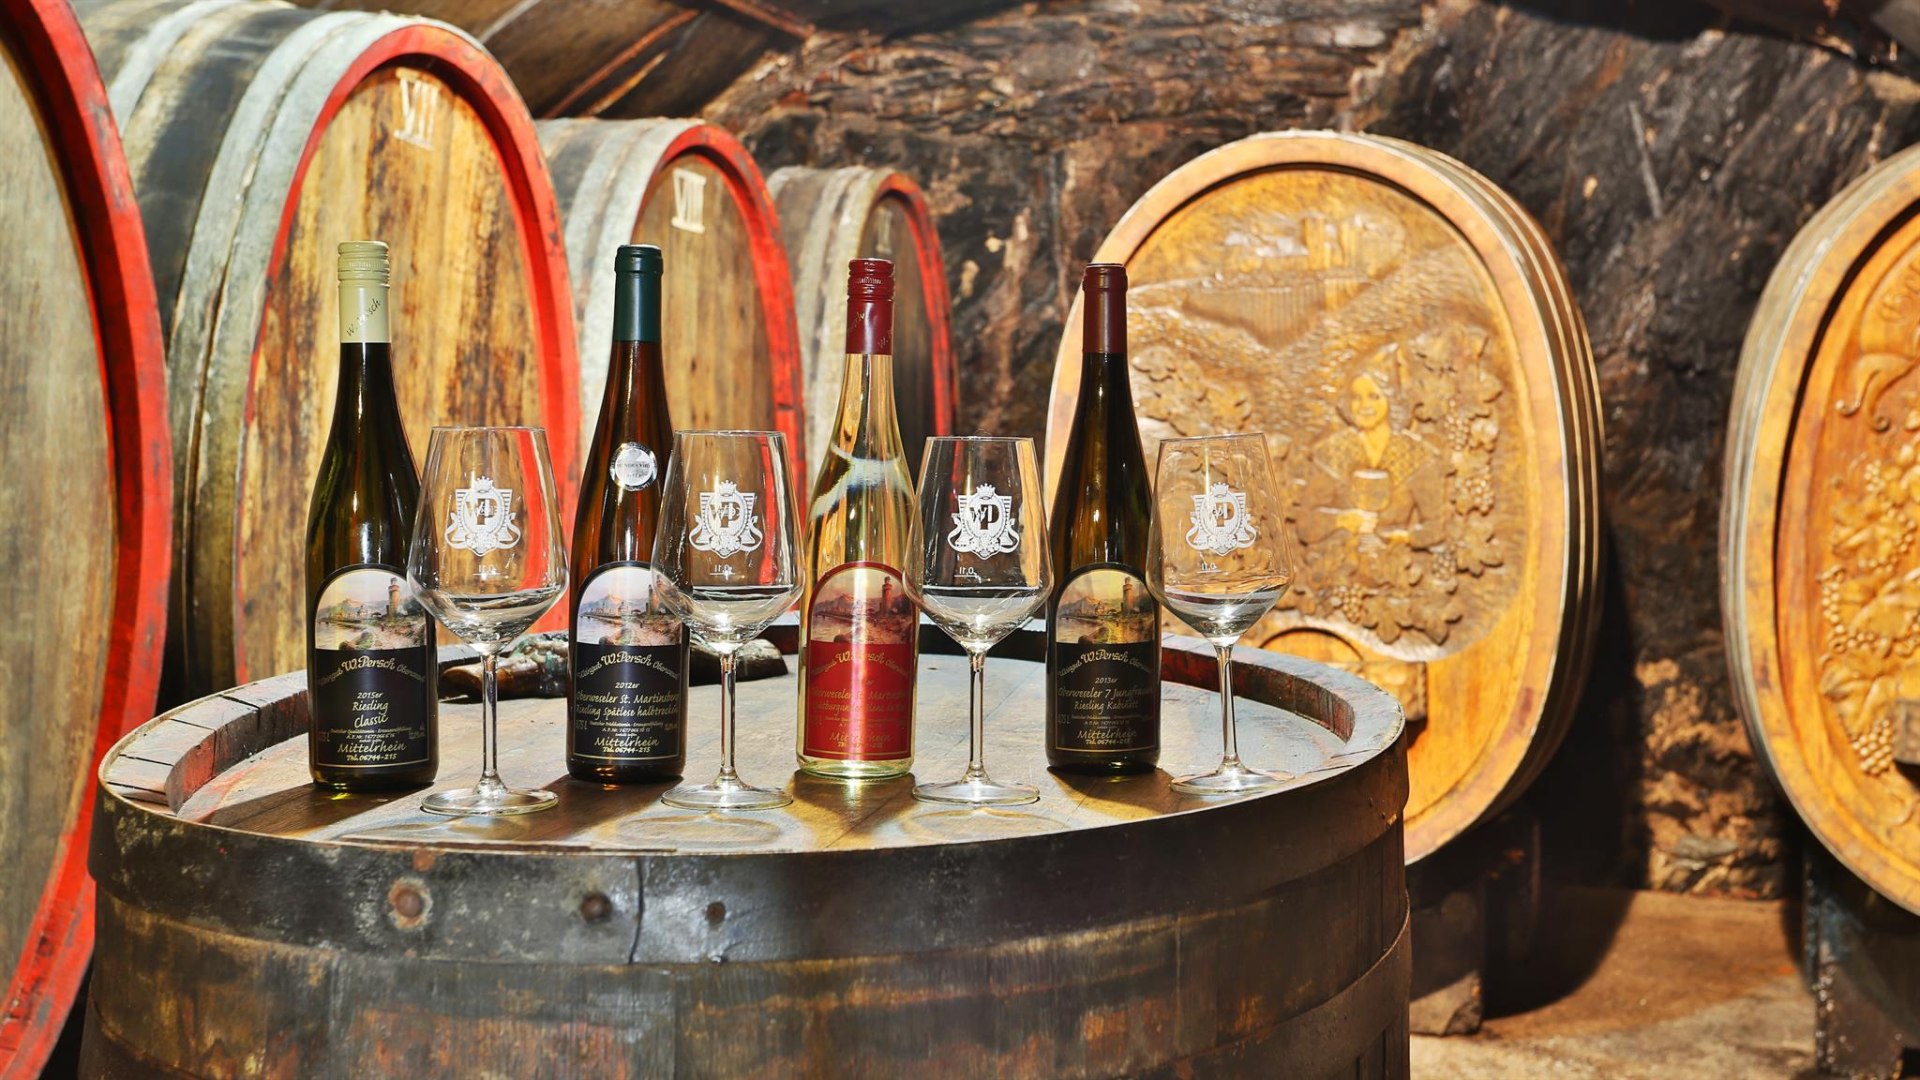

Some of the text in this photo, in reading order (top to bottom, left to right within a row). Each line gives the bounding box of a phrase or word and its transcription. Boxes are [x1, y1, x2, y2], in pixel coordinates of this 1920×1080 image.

[394, 66, 441, 151] VII
[1095, 676, 1119, 684] 2013er
[356, 691, 384, 700] 2015er
[1105, 689, 1112, 698] 7
[352, 700, 389, 714] Riesling
[603, 705, 636, 721] Spätlese
[354, 711, 389, 728] Classic
[337, 740, 407, 754] Mittelrhein
[594, 736, 660, 747] Mittelrhein
